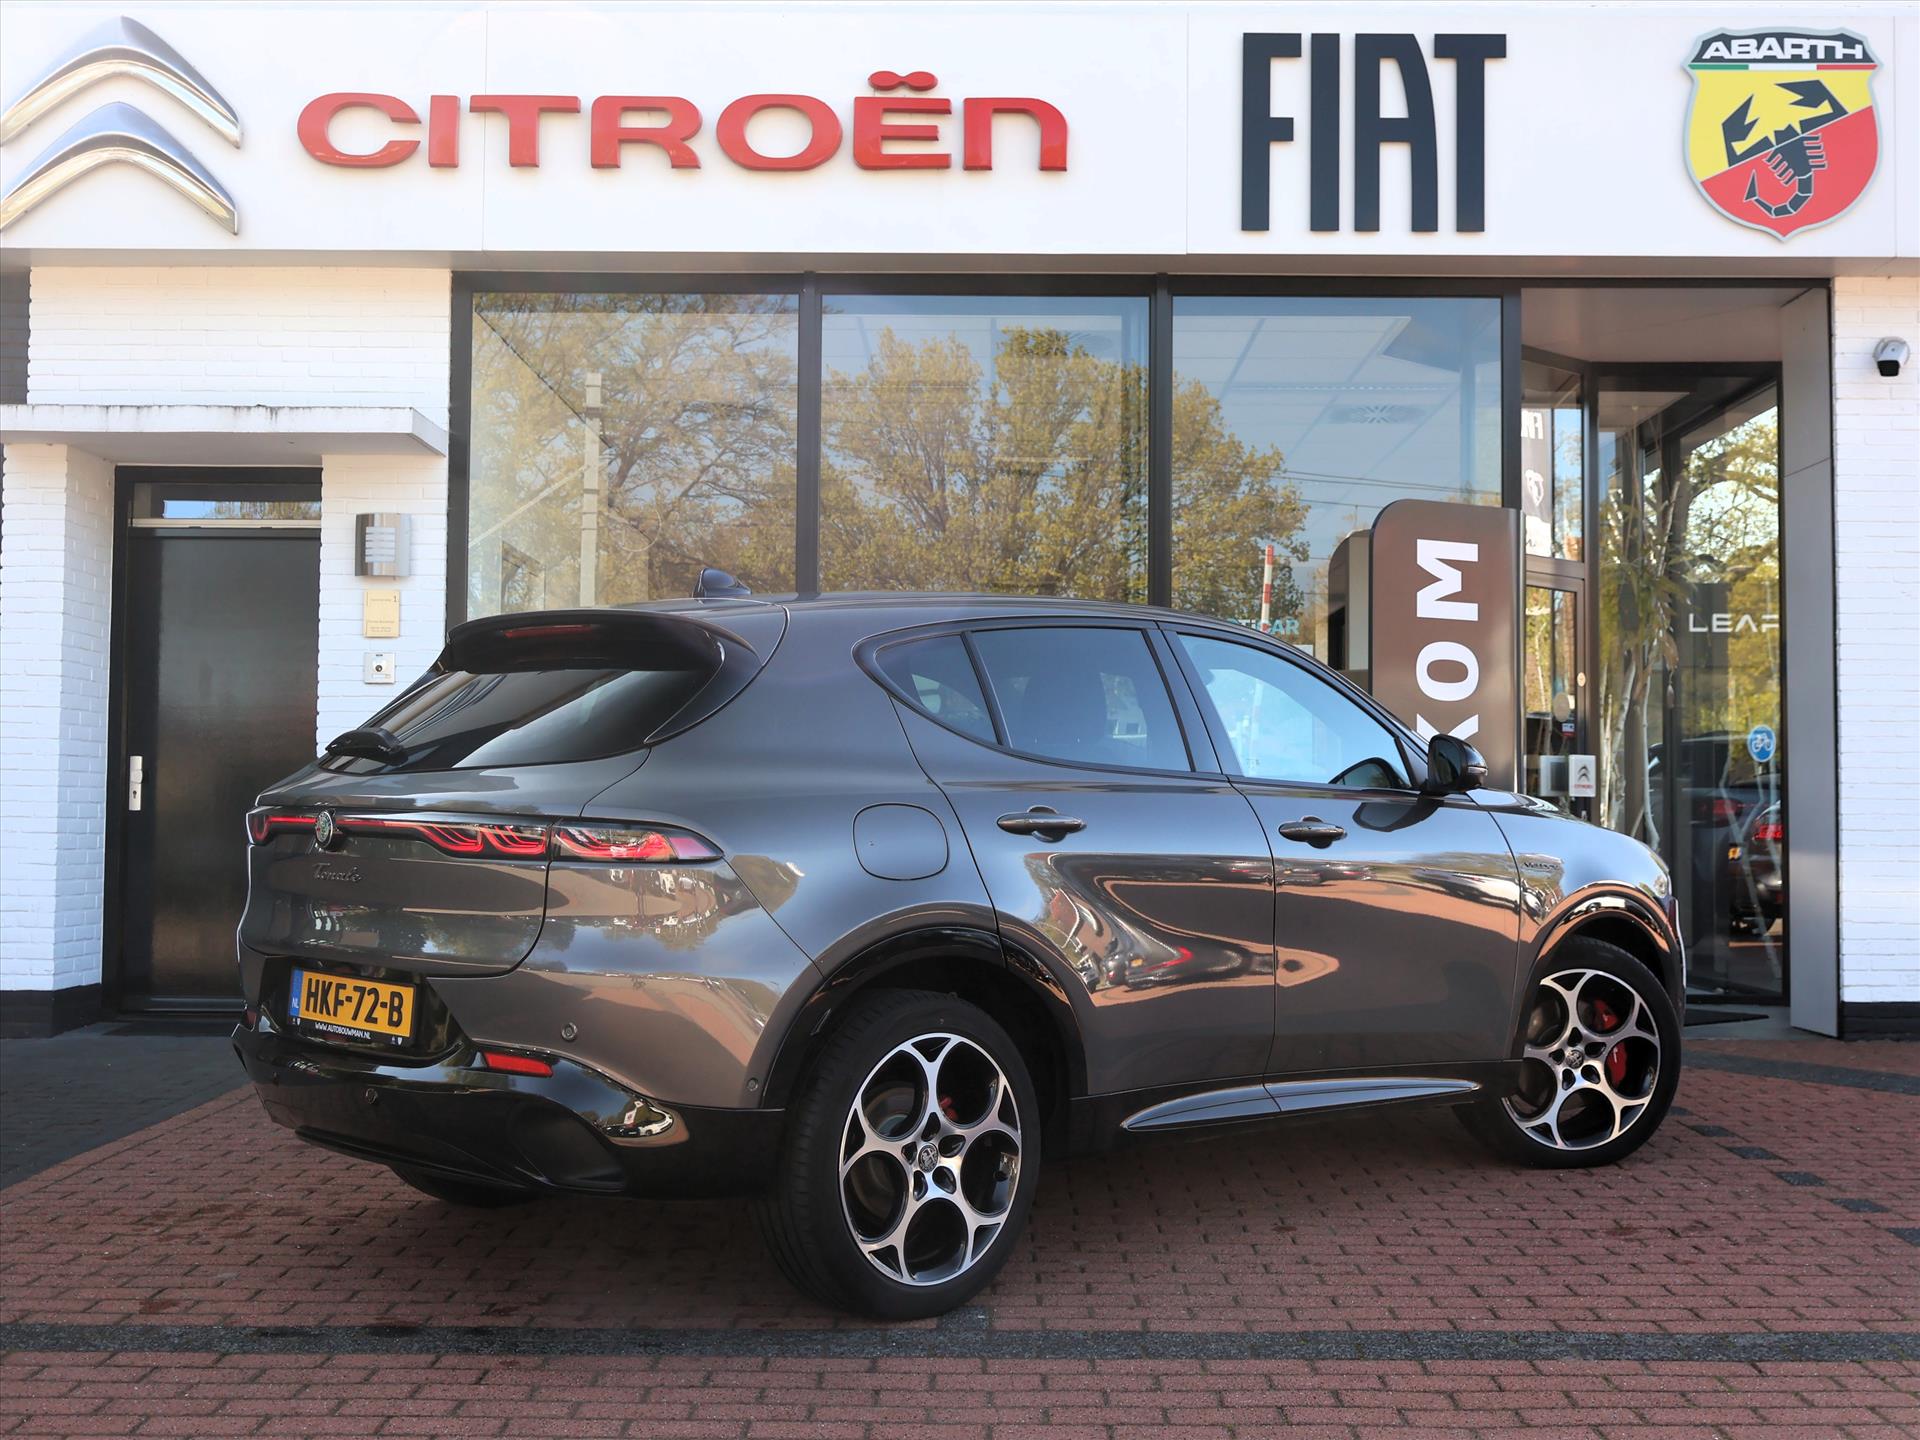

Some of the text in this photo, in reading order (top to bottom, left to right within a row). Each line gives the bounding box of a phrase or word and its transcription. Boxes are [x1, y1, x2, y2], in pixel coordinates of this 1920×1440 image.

[1702, 37, 1864, 60] ABARTH
[1241, 33, 1507, 232] FIAT
[291, 996, 300, 1009] NL
[305, 977, 404, 1028] HKF-72-B
